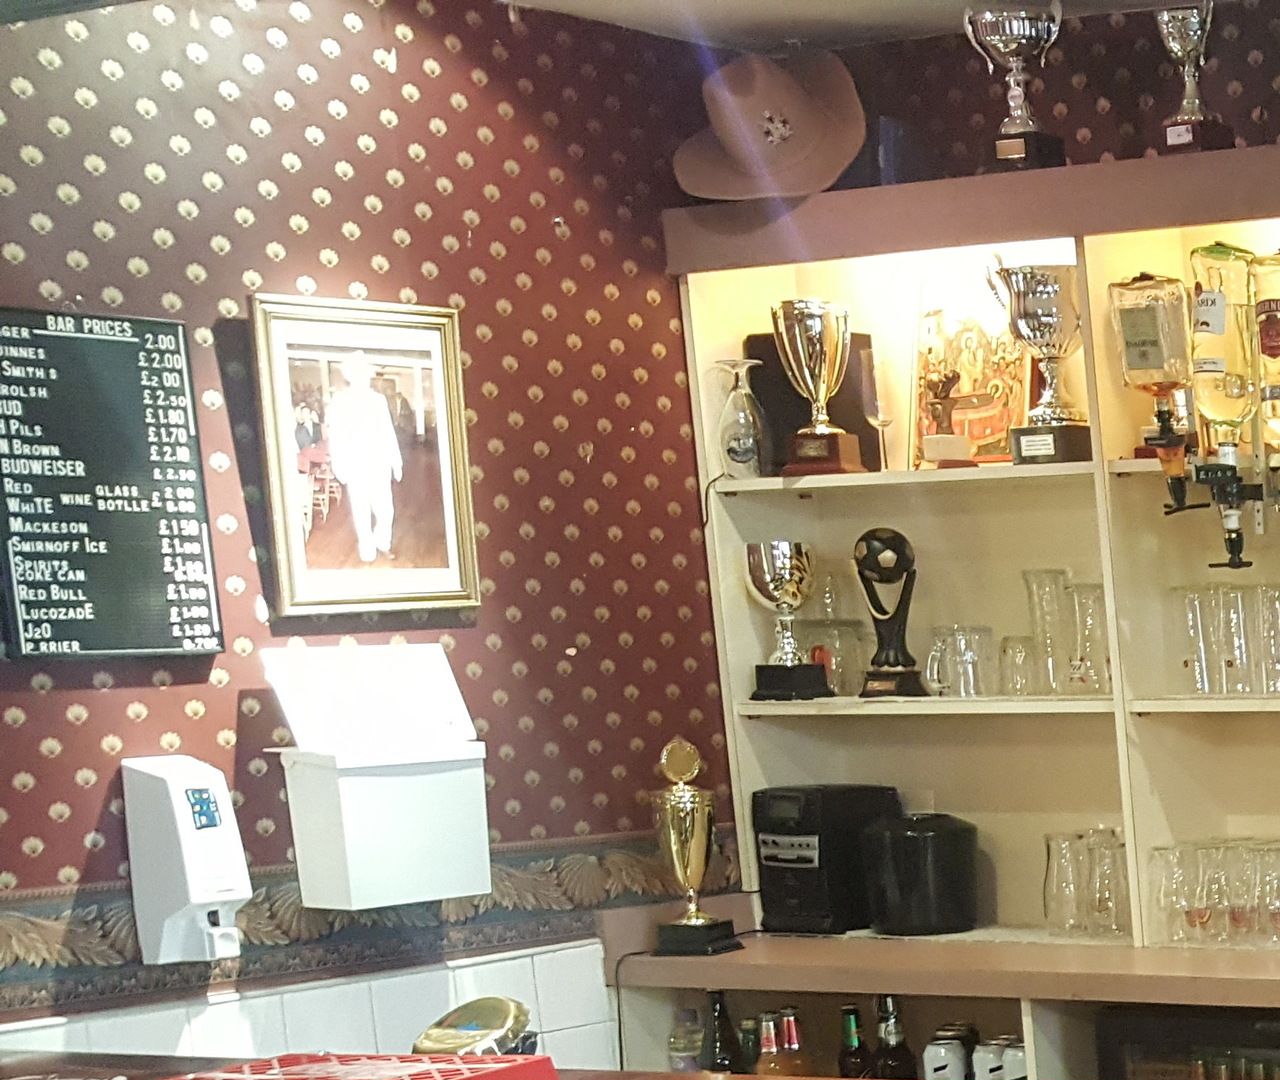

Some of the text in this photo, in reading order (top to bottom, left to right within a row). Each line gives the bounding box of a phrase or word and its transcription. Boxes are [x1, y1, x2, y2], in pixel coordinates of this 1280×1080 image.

[0, 326, 31, 339] GER
[46, 314, 133, 337] BAR PRICES
[0, 399, 23, 416] UD
[9, 418, 43, 437] PILS
[12, 438, 61, 457] BROWN
[0, 457, 87, 477] BUDWEISER
[3, 477, 33, 494] RED
[95, 484, 139, 498] GLASS
[6, 497, 55, 515] WHITE
[60, 493, 93, 506] WINE
[97, 499, 150, 513] BOTLLE
[9, 516, 88, 534] MACKESON
[11, 535, 80, 553] SMIRNOFF
[84, 536, 108, 554] ICE
[14, 555, 69, 572] SPIRITS
[16, 569, 86, 581] COKE CAN
[18, 583, 47, 601] RED
[50, 583, 87, 601] BULL
[20, 602, 95, 620] LUCOZADE
